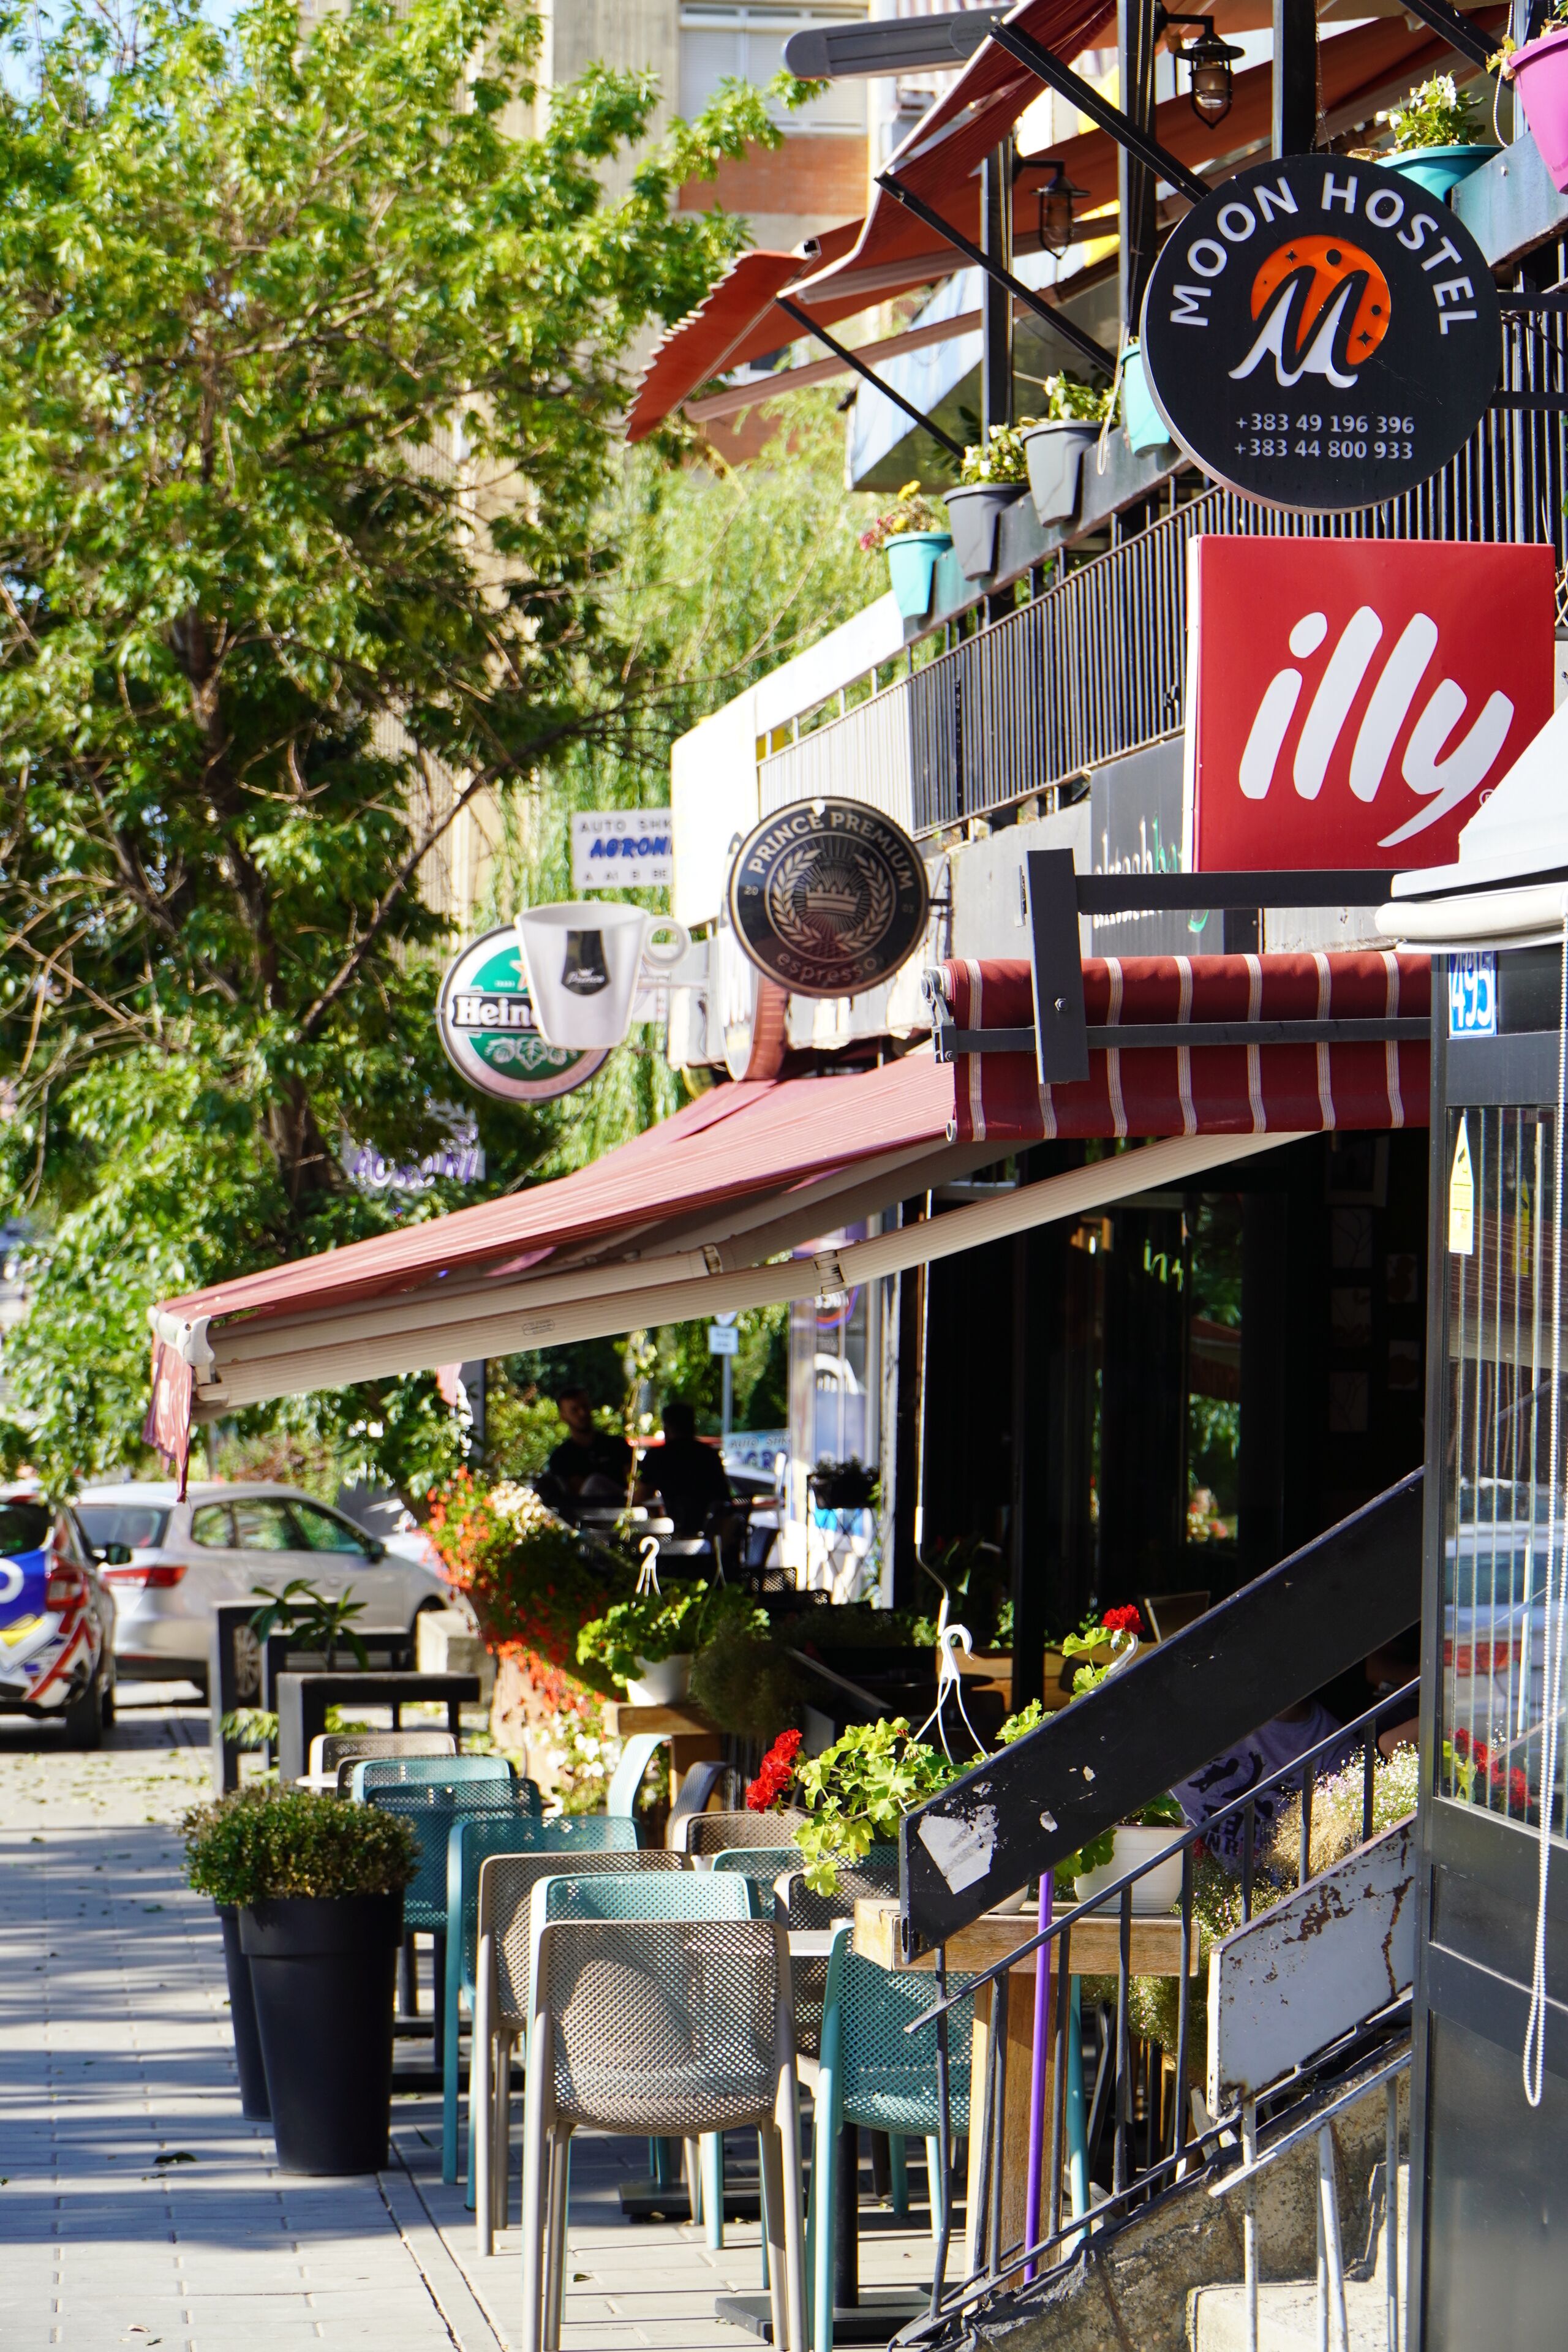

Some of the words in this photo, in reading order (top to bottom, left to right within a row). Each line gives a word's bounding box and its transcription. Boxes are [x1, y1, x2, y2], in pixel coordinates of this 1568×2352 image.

[1170, 176, 1298, 326] MOON
[1321, 172, 1477, 335] HOSTEL
[1235, 413, 1289, 432] +383
[1295, 414, 1323, 432] 49
[1330, 415, 1369, 434] 196
[1375, 416, 1415, 435] 396
[1234, 438, 1288, 457] +383
[1294, 440, 1321, 458] 44
[1328, 440, 1367, 459] 800
[1373, 441, 1414, 460] 933
[1238, 605, 1515, 848] illy
[580, 819, 627, 833] AUTO
[747, 812, 825, 875] PRINCE
[830, 811, 914, 891] PREMIUM
[777, 952, 877, 982] espresso
[766, 1434, 791, 1446] SHK
